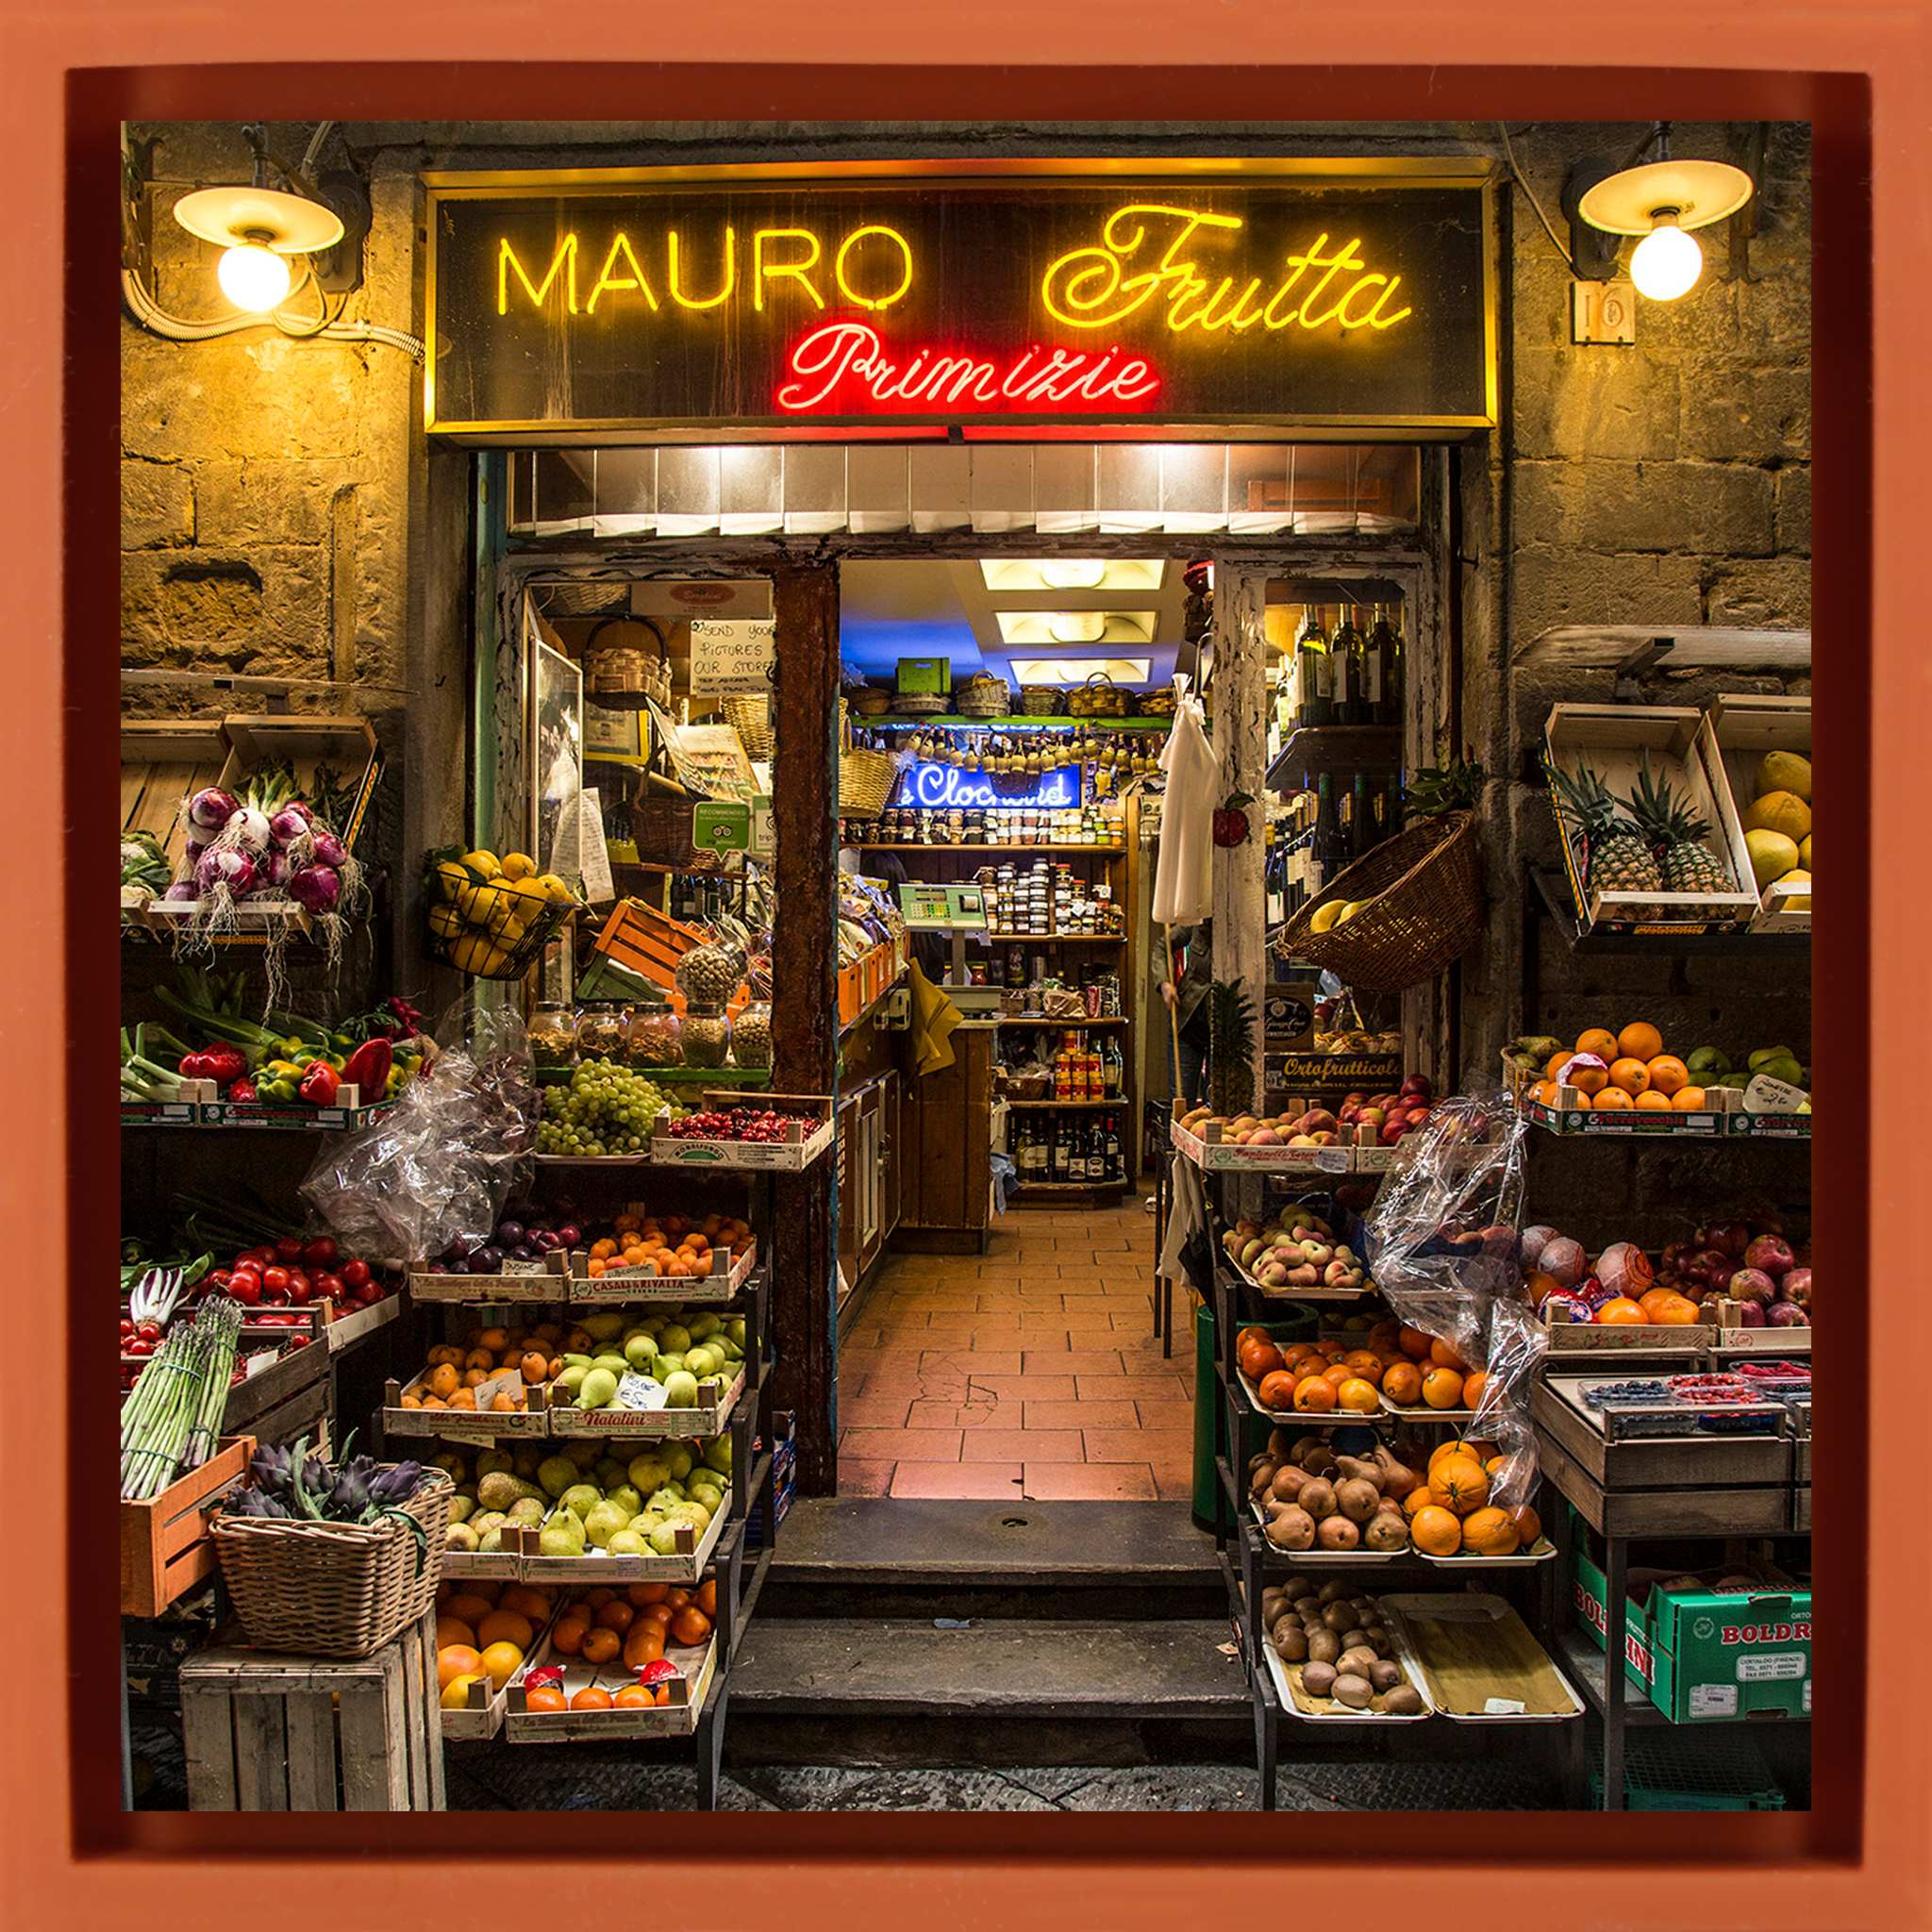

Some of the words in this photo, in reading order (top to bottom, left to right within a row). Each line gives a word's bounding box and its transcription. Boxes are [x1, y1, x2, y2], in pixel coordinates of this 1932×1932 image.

[497, 225, 913, 315] MAURO
[1042, 204, 1412, 332] Frutta
[1585, 287, 1624, 328] 16
[777, 323, 1159, 411] Primizie
[703, 625, 735, 637] SEND
[699, 641, 763, 657] PICTURES
[693, 660, 721, 675] OUR
[592, 1279, 631, 1292] CASALI
[641, 1279, 685, 1290] RIVALTA
[583, 1411, 646, 1426] Natalini
[1721, 1623, 1811, 1645] BOLDR
